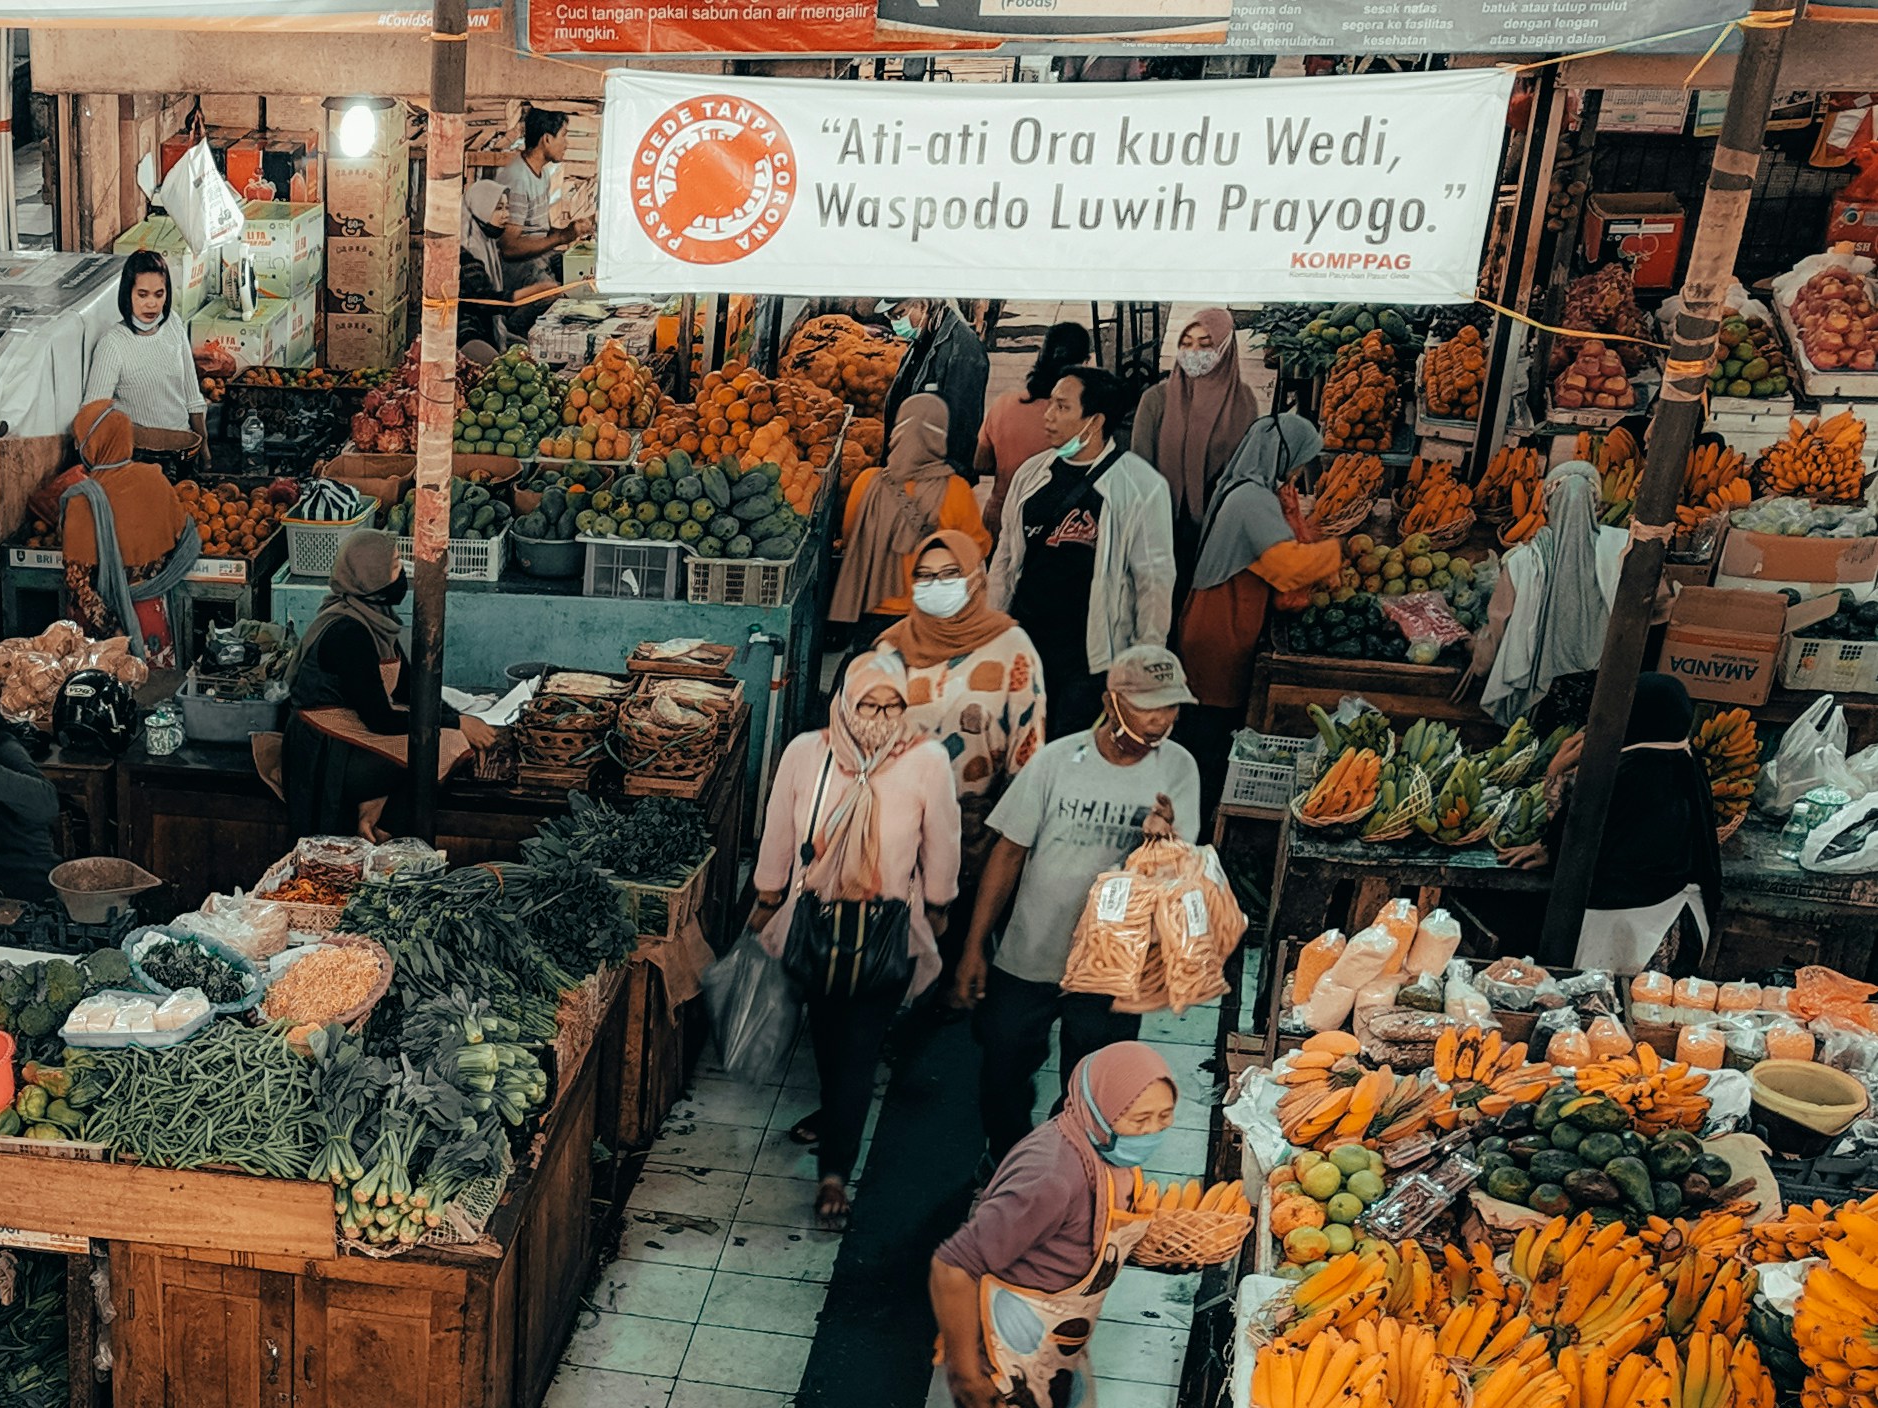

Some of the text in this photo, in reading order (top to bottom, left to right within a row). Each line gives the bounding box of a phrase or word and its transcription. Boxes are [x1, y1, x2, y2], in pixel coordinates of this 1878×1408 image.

[555, 4, 588, 20] Cuci
[591, 6, 643, 23] tangan
[648, 6, 688, 24] pakai
[692, 6, 738, 20] sabun
[742, 5, 772, 20] dan
[776, 5, 797, 19] air
[800, 3, 869, 23] mengalir
[1231, 4, 1302, 17] mpurna dan
[1363, 3, 1438, 14] sesak nafas
[1481, 1, 1628, 15] batuk atau tutup mulut
[1252, 20, 1294, 32] daging
[1341, 18, 1454, 32] segera ke fasilitas
[1503, 17, 1599, 30] dengan lengan
[554, 26, 620, 42] mungkin.
[1363, 35, 1427, 46] kesehatan
[1489, 33, 1606, 46] atas bagian dalam
[1263, 36, 1334, 47] menularkan
[1010, 116, 1096, 166] Ora
[1115, 115, 1241, 166] kudu
[1266, 115, 1402, 174] Wedi,
[637, 101, 791, 251] PASAR GEDE TANPA CORONA
[815, 181, 1467, 245] Waspodo Luwih Prayogo.”
[1290, 252, 1412, 270] KOMPPAG
[36, 552, 53, 565] BRI
[1670, 655, 1760, 681] AMANDA
